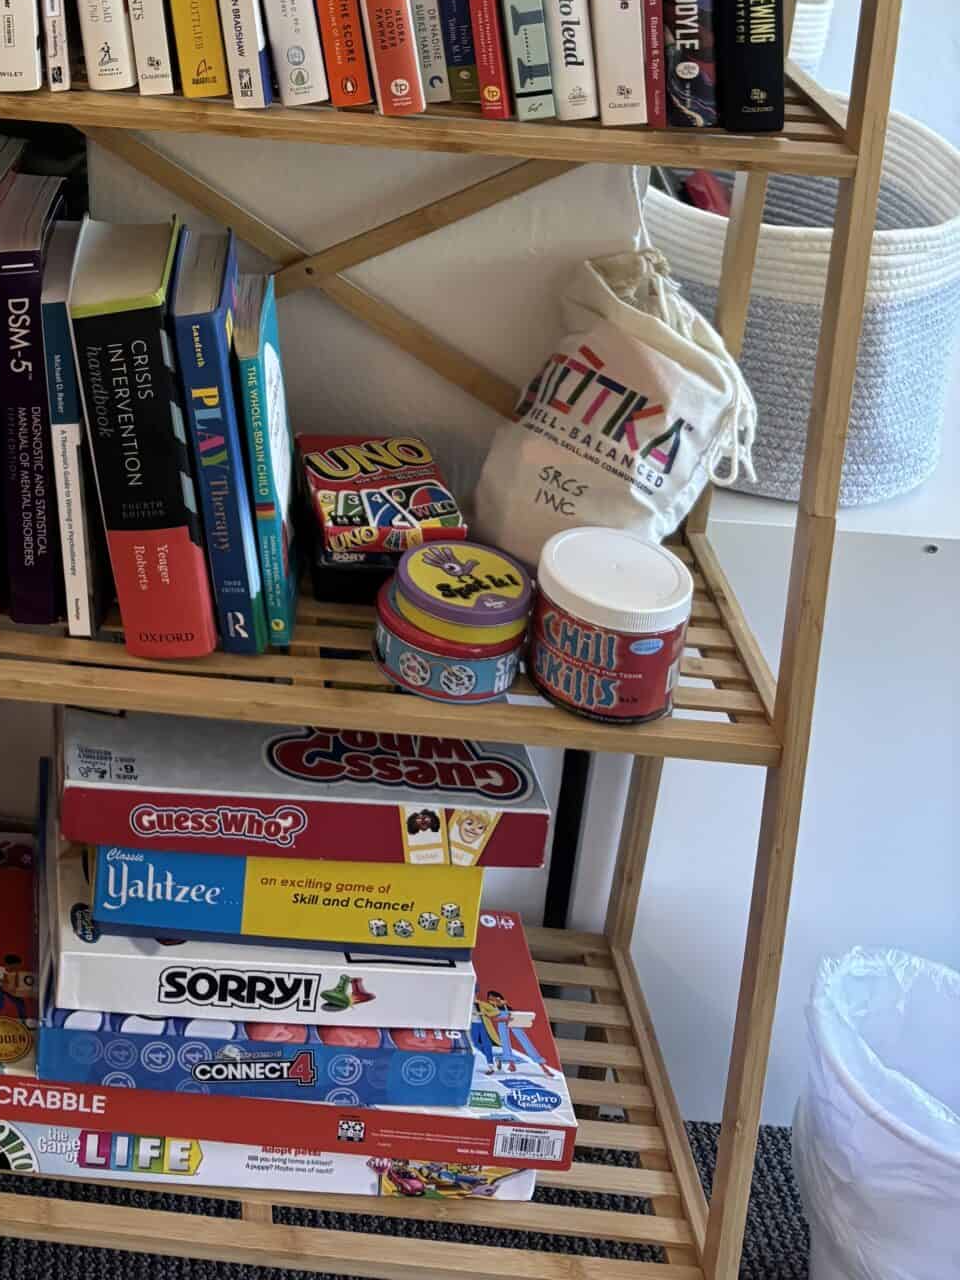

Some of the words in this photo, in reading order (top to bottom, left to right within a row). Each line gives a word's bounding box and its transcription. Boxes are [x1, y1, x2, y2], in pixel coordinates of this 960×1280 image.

[232, 9, 246, 58] BRADSHAW
[343, 24, 356, 64] SCORE
[560, 17, 586, 67] lead
[7, 297, 33, 373] DSM-5
[130, 339, 155, 401] CRISIS
[246, 366, 257, 387] THE
[86, 345, 116, 439] handbook
[17, 407, 30, 451] MANUAL
[107, 342, 143, 487] INTERVENTION
[191, 386, 230, 472] PLAY
[248, 390, 264, 460] WHOLE-BRAIN
[31, 406, 45, 471] DIAGNOSTIC
[59, 436, 69, 469] Therapist's
[20, 452, 31, 468] OF
[304, 437, 433, 481] UNO
[21, 470, 32, 509] MENTAL
[34, 474, 46, 496] AND
[62, 470, 71, 489] Guide
[256, 463, 269, 496] CHILD
[539, 466, 589, 497] SRCS
[36, 499, 48, 556] STATISTICAL
[64, 499, 74, 523] Writing
[207, 474, 232, 552] Therapy
[22, 511, 35, 567] DISORDERS
[67, 531, 77, 577] Psychotherapy
[329, 527, 378, 553] UNO
[436, 576, 491, 600] Spot
[139, 632, 195, 642] OXFORD
[134, 808, 219, 834] Guess
[220, 809, 303, 842] Who?
[106, 847, 144, 862] Classic
[102, 861, 222, 910] Yahtzee
[259, 875, 277, 887] an
[279, 877, 330, 894] exciting
[333, 881, 374, 895] game
[377, 883, 391, 895] of
[292, 892, 321, 906] Skill
[323, 895, 350, 908] and
[353, 898, 415, 913] Chance!
[164, 971, 314, 1007] SORRY!
[194, 1062, 290, 1080] CONNECT
[288, 1052, 314, 1083] 4
[39, 1135, 80, 1154] Game
[48, 1128, 68, 1142] the
[84, 1133, 193, 1171] LIFE
[65, 1150, 79, 1164] of
